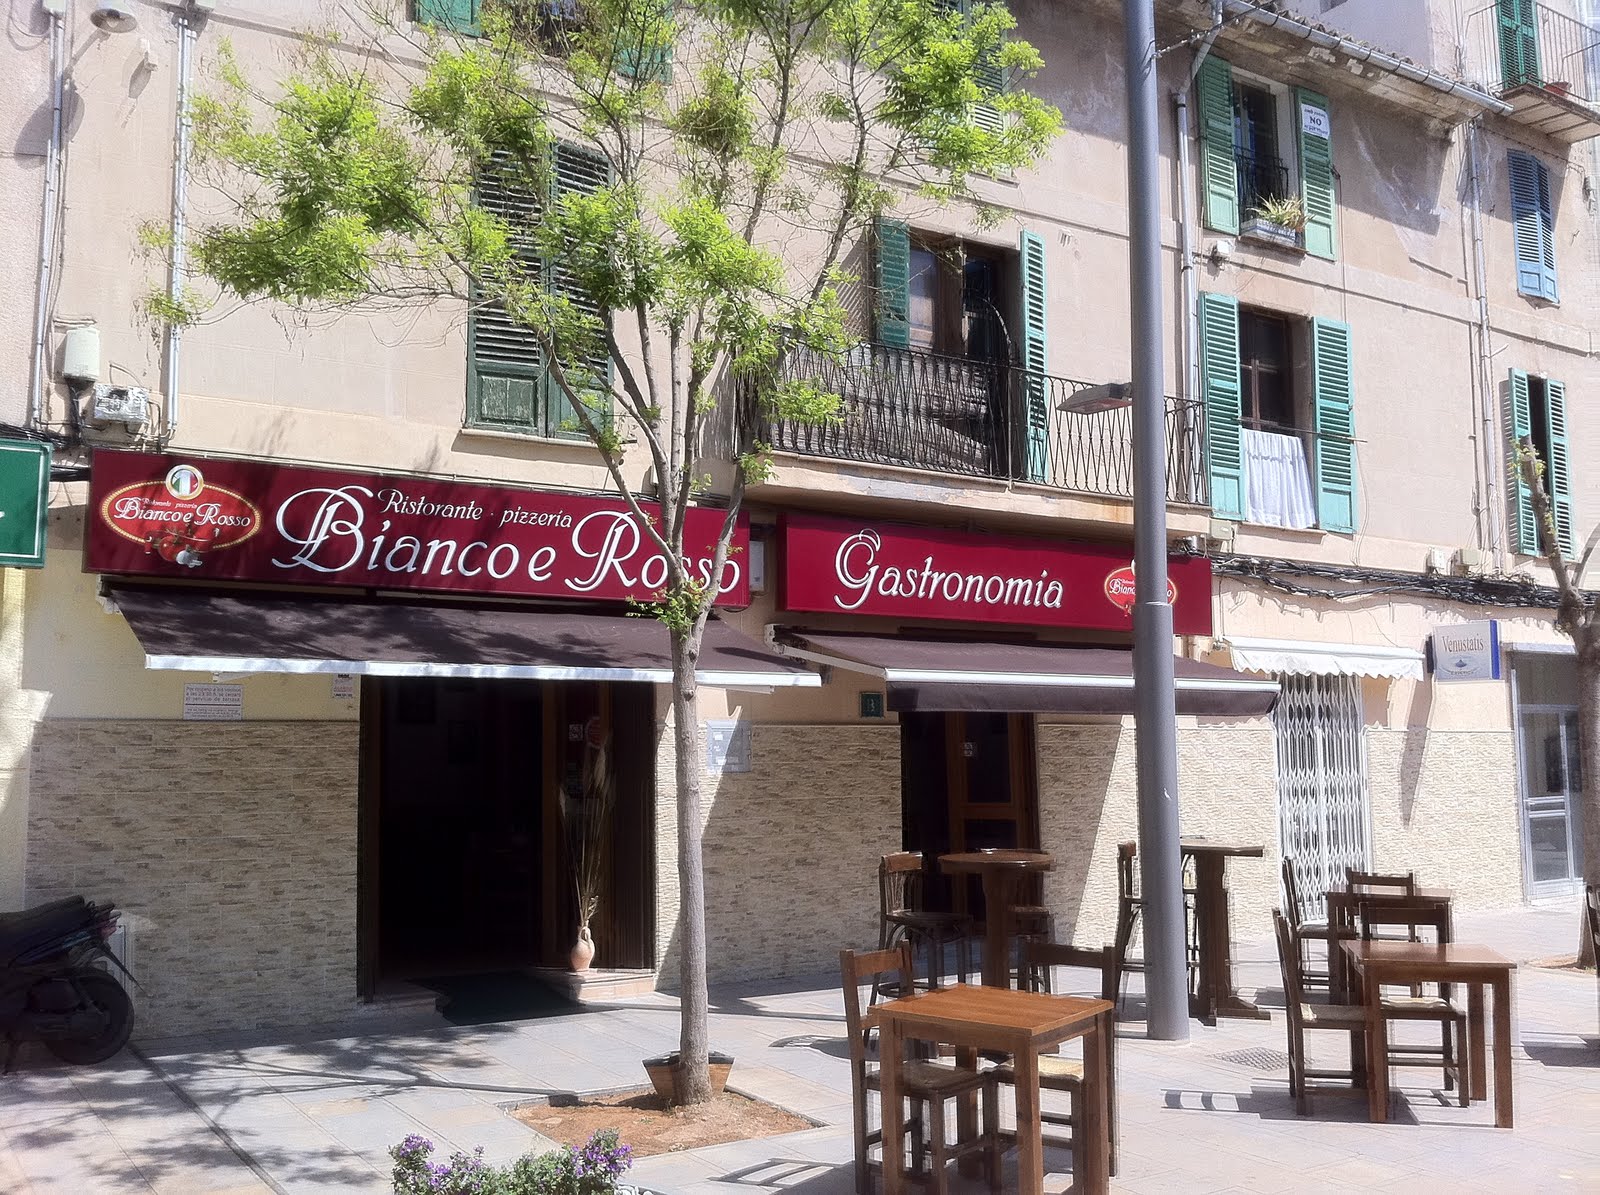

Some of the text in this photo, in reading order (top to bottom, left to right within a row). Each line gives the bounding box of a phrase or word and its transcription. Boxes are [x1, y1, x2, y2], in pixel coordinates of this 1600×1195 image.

[1310, 116, 1322, 126] NO
[113, 496, 251, 527] Bianco e Rosso
[377, 488, 573, 529] Ristorante pizzeria
[272, 485, 520, 579] Bianco
[527, 546, 557, 582] e
[833, 528, 1064, 611] Gastronomia
[1109, 578, 1136, 596] Bianc
[1441, 632, 1484, 653] Venustatis
